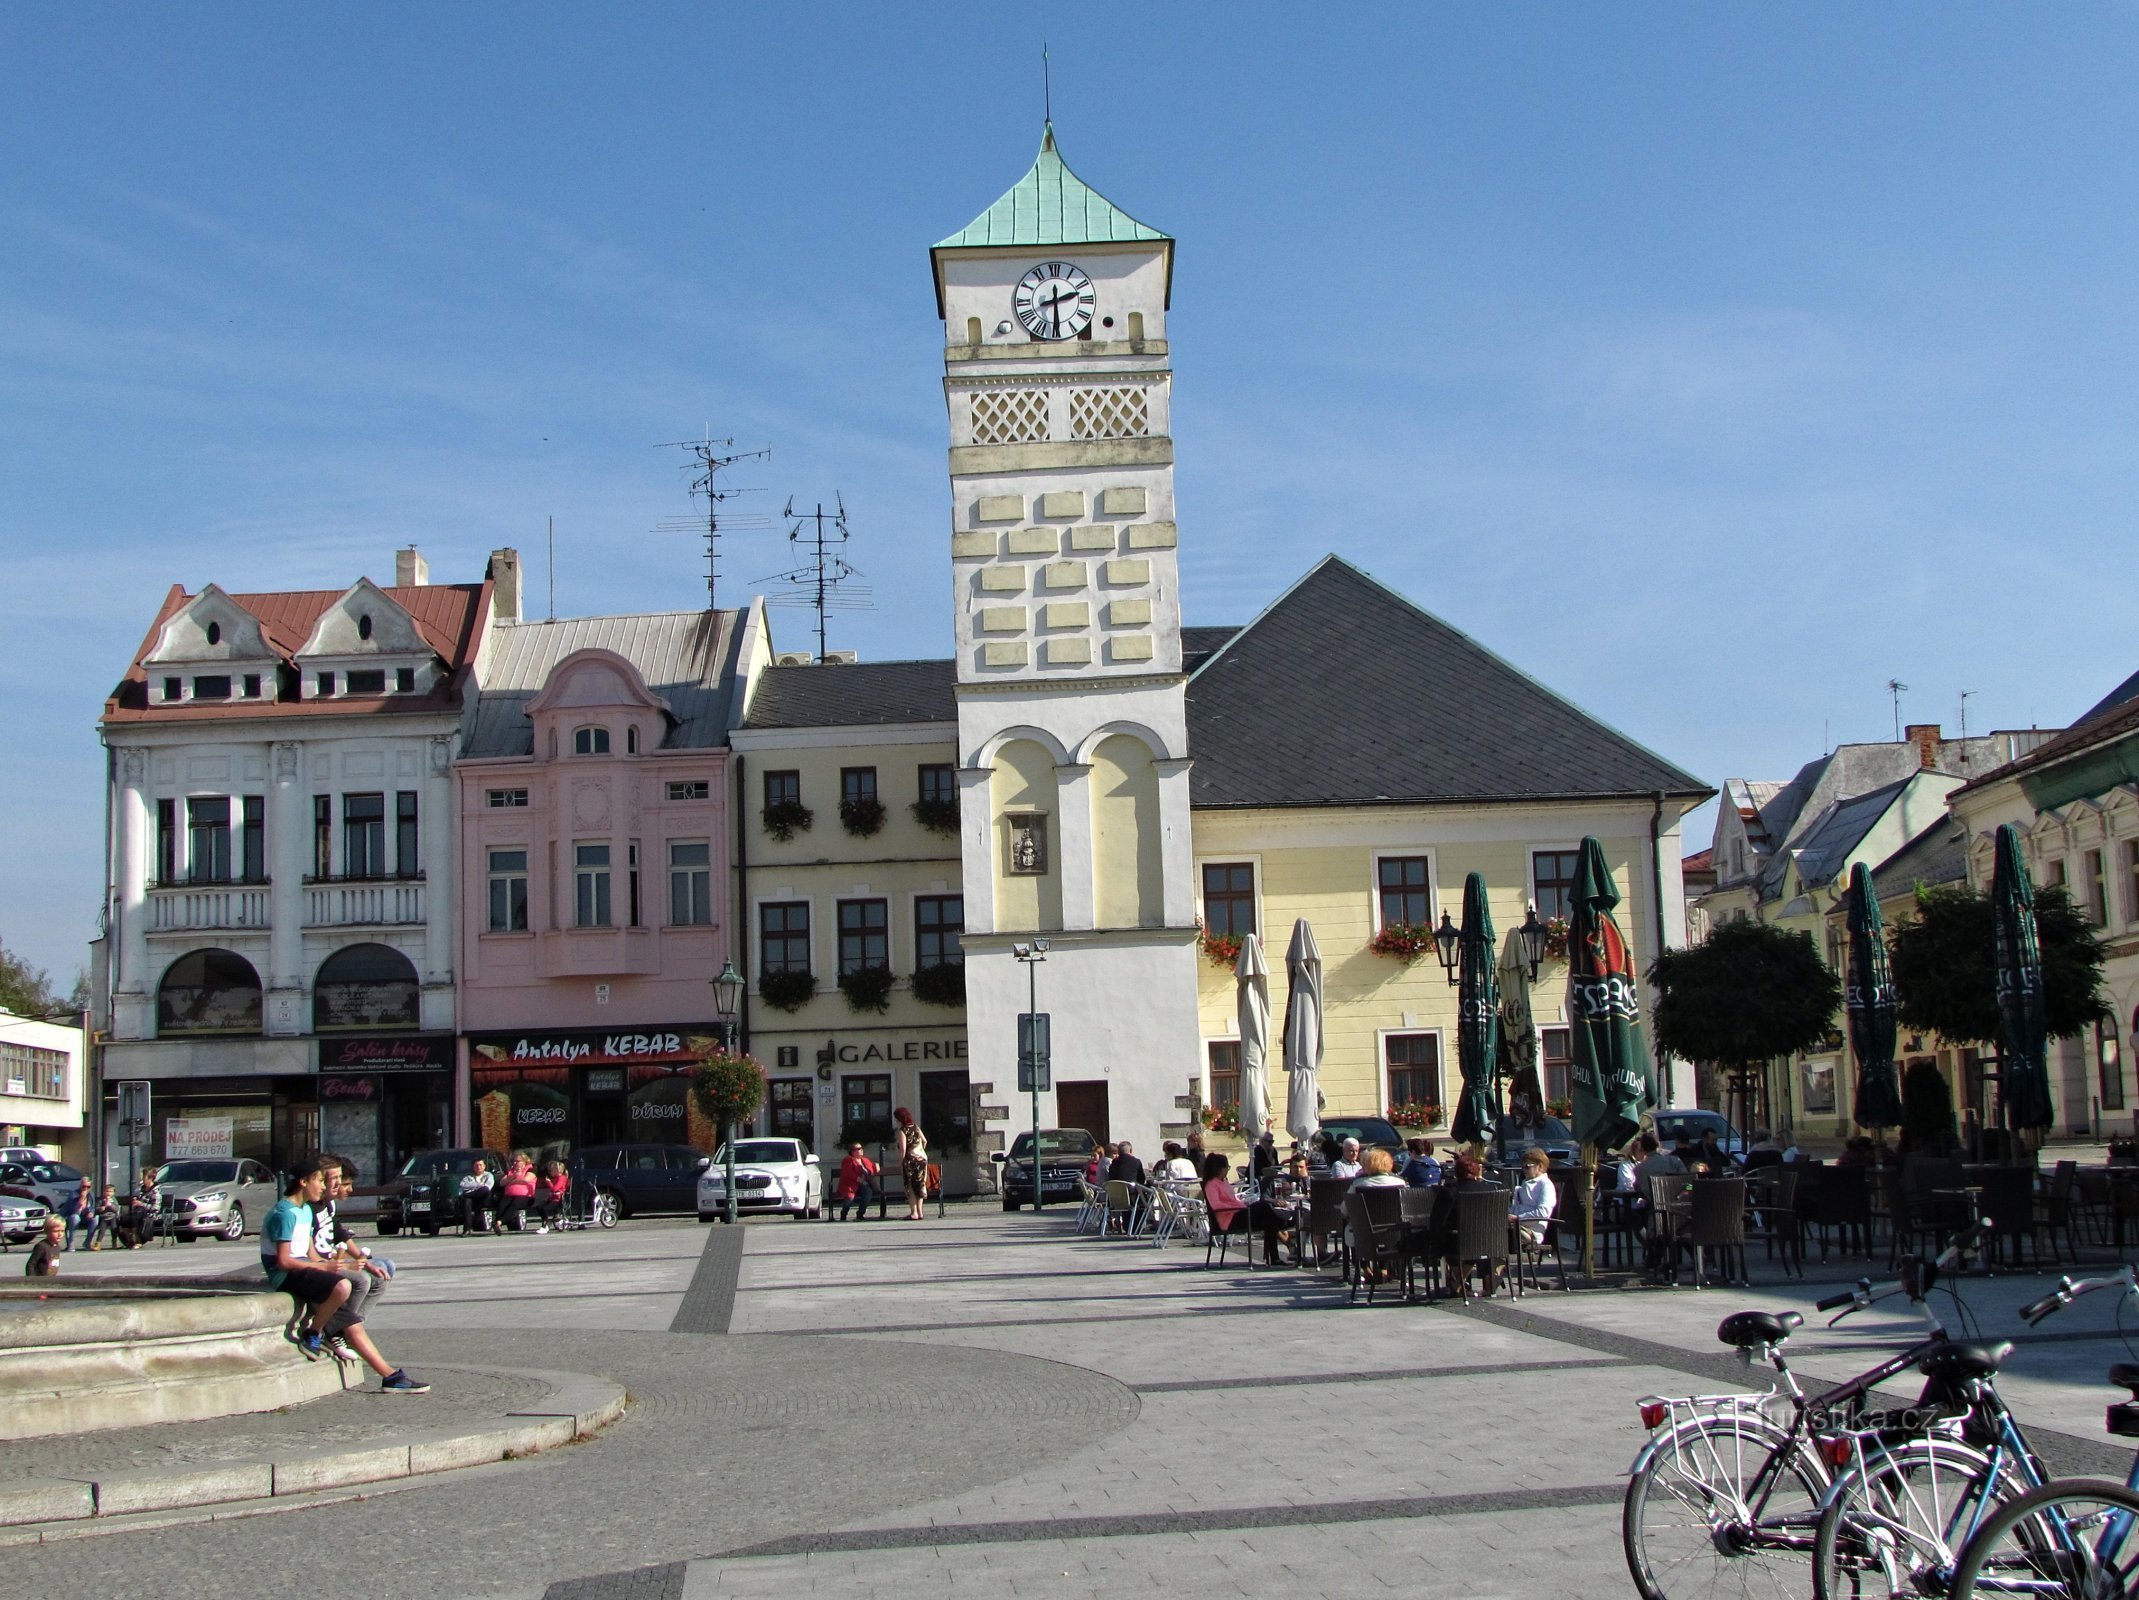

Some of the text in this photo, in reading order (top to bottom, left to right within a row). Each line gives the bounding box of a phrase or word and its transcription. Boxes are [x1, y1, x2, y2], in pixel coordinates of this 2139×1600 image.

[1048, 264, 1061, 277] XII
[1080, 294, 1094, 304] III
[513, 1033, 681, 1062] Antalya KEBAB
[838, 1040, 968, 1062] GALERIE
[517, 1108, 566, 1124] KEBAB
[631, 1102, 684, 1120] DÜRUM
[168, 1130, 232, 1144] NA PRODEJ
[172, 1146, 188, 1155] 777
[210, 1144, 227, 1154] 670
